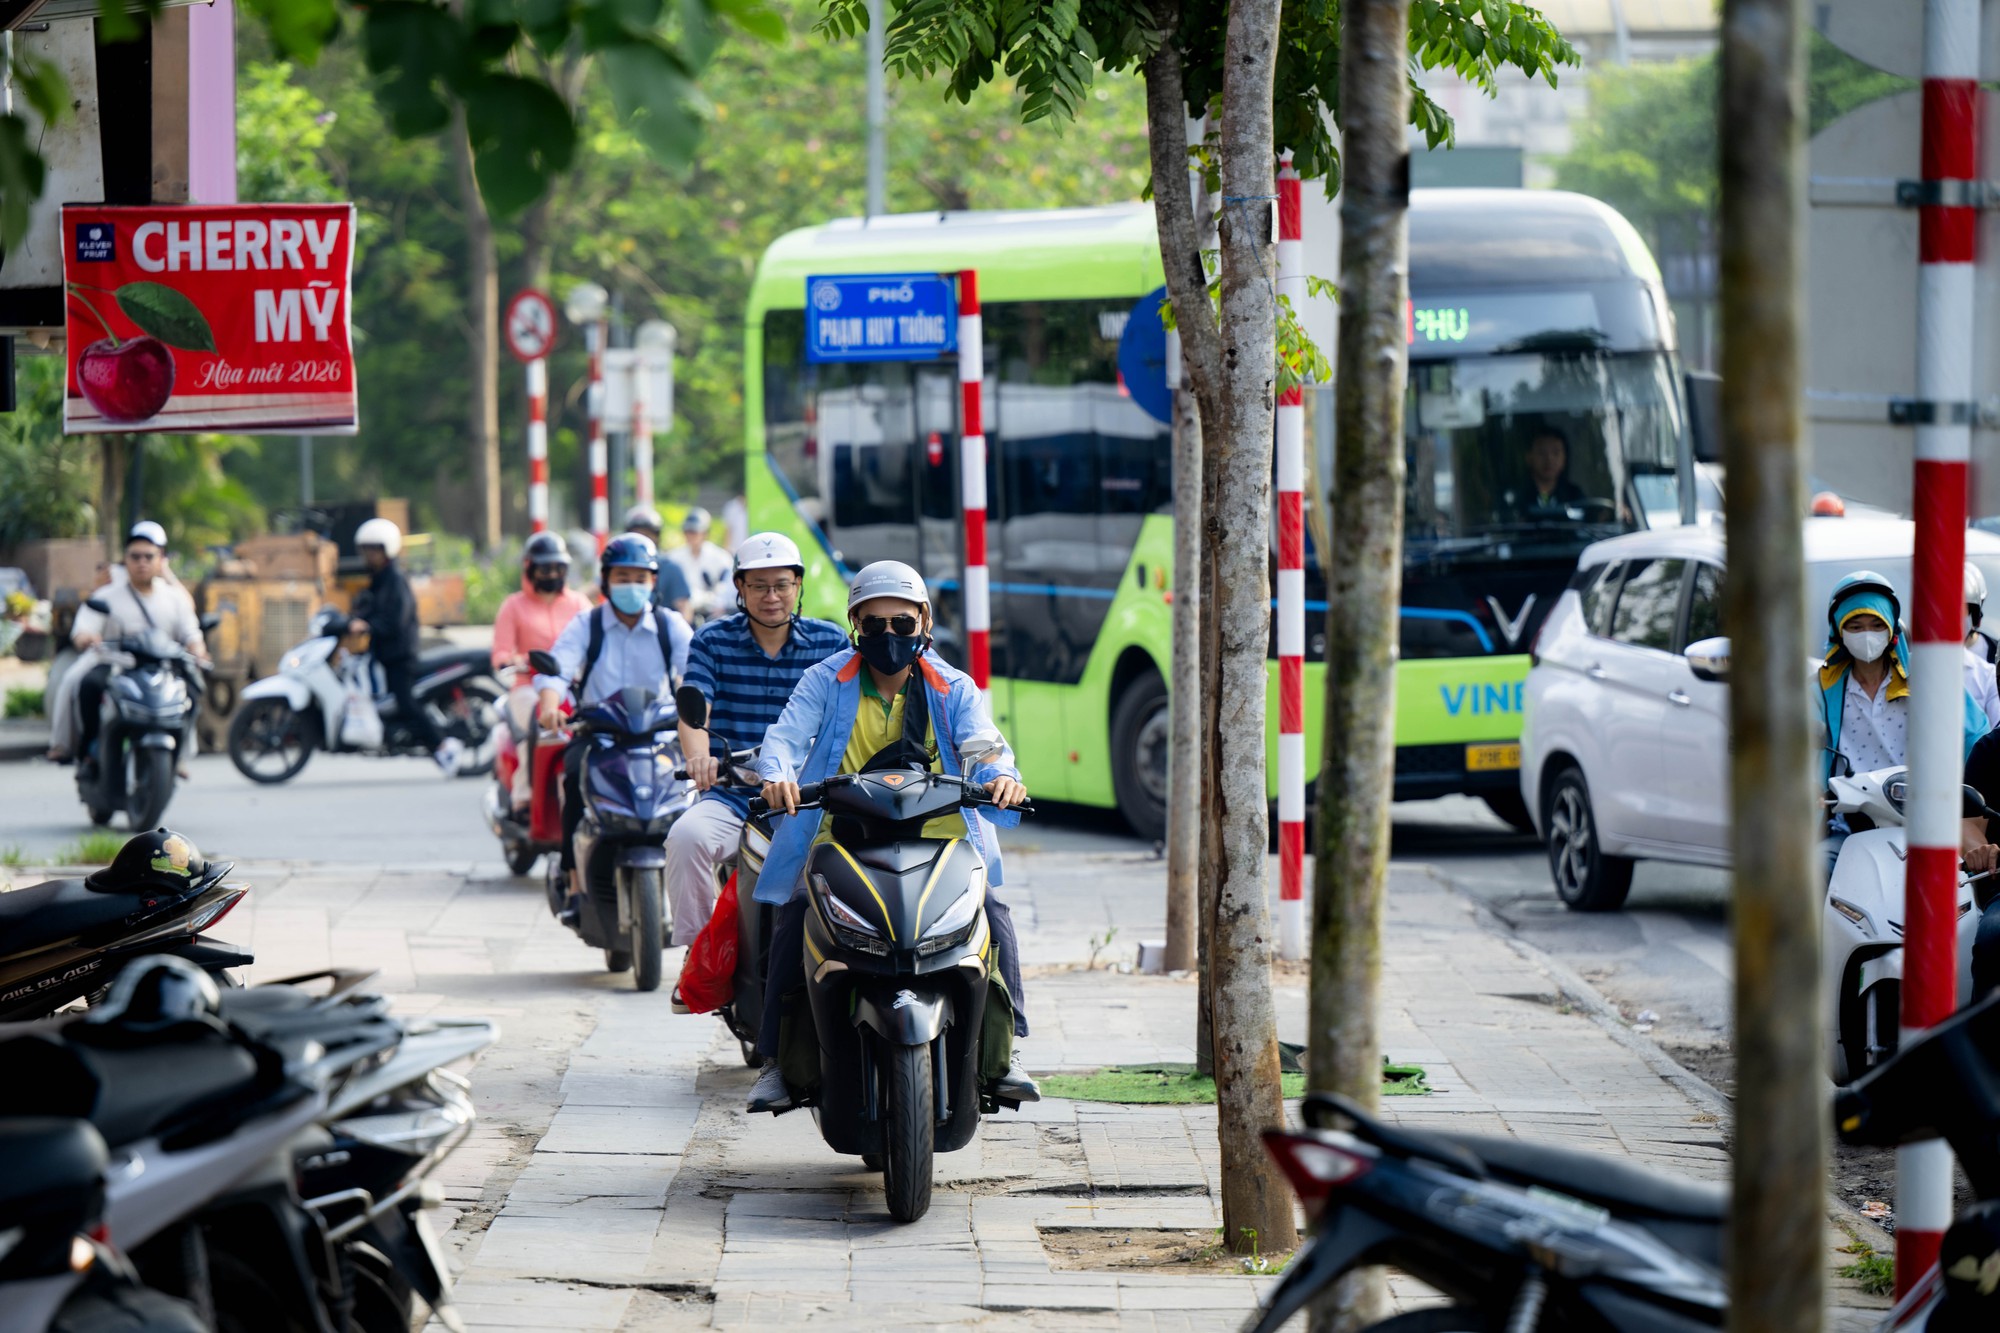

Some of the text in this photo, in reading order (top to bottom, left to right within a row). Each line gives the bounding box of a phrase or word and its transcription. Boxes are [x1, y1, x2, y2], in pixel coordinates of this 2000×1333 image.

[79, 241, 112, 250] KLEVER
[84, 250, 107, 258] FRUIT
[132, 219, 341, 273] CHERRY
[868, 279, 915, 303] PHỐ
[254, 280, 340, 343] MỸ
[866, 316, 895, 346] HUY
[194, 359, 342, 390] Mùa mới 2026
[1, 985, 34, 1001] AIR
[37, 959, 102, 988] BLADE
